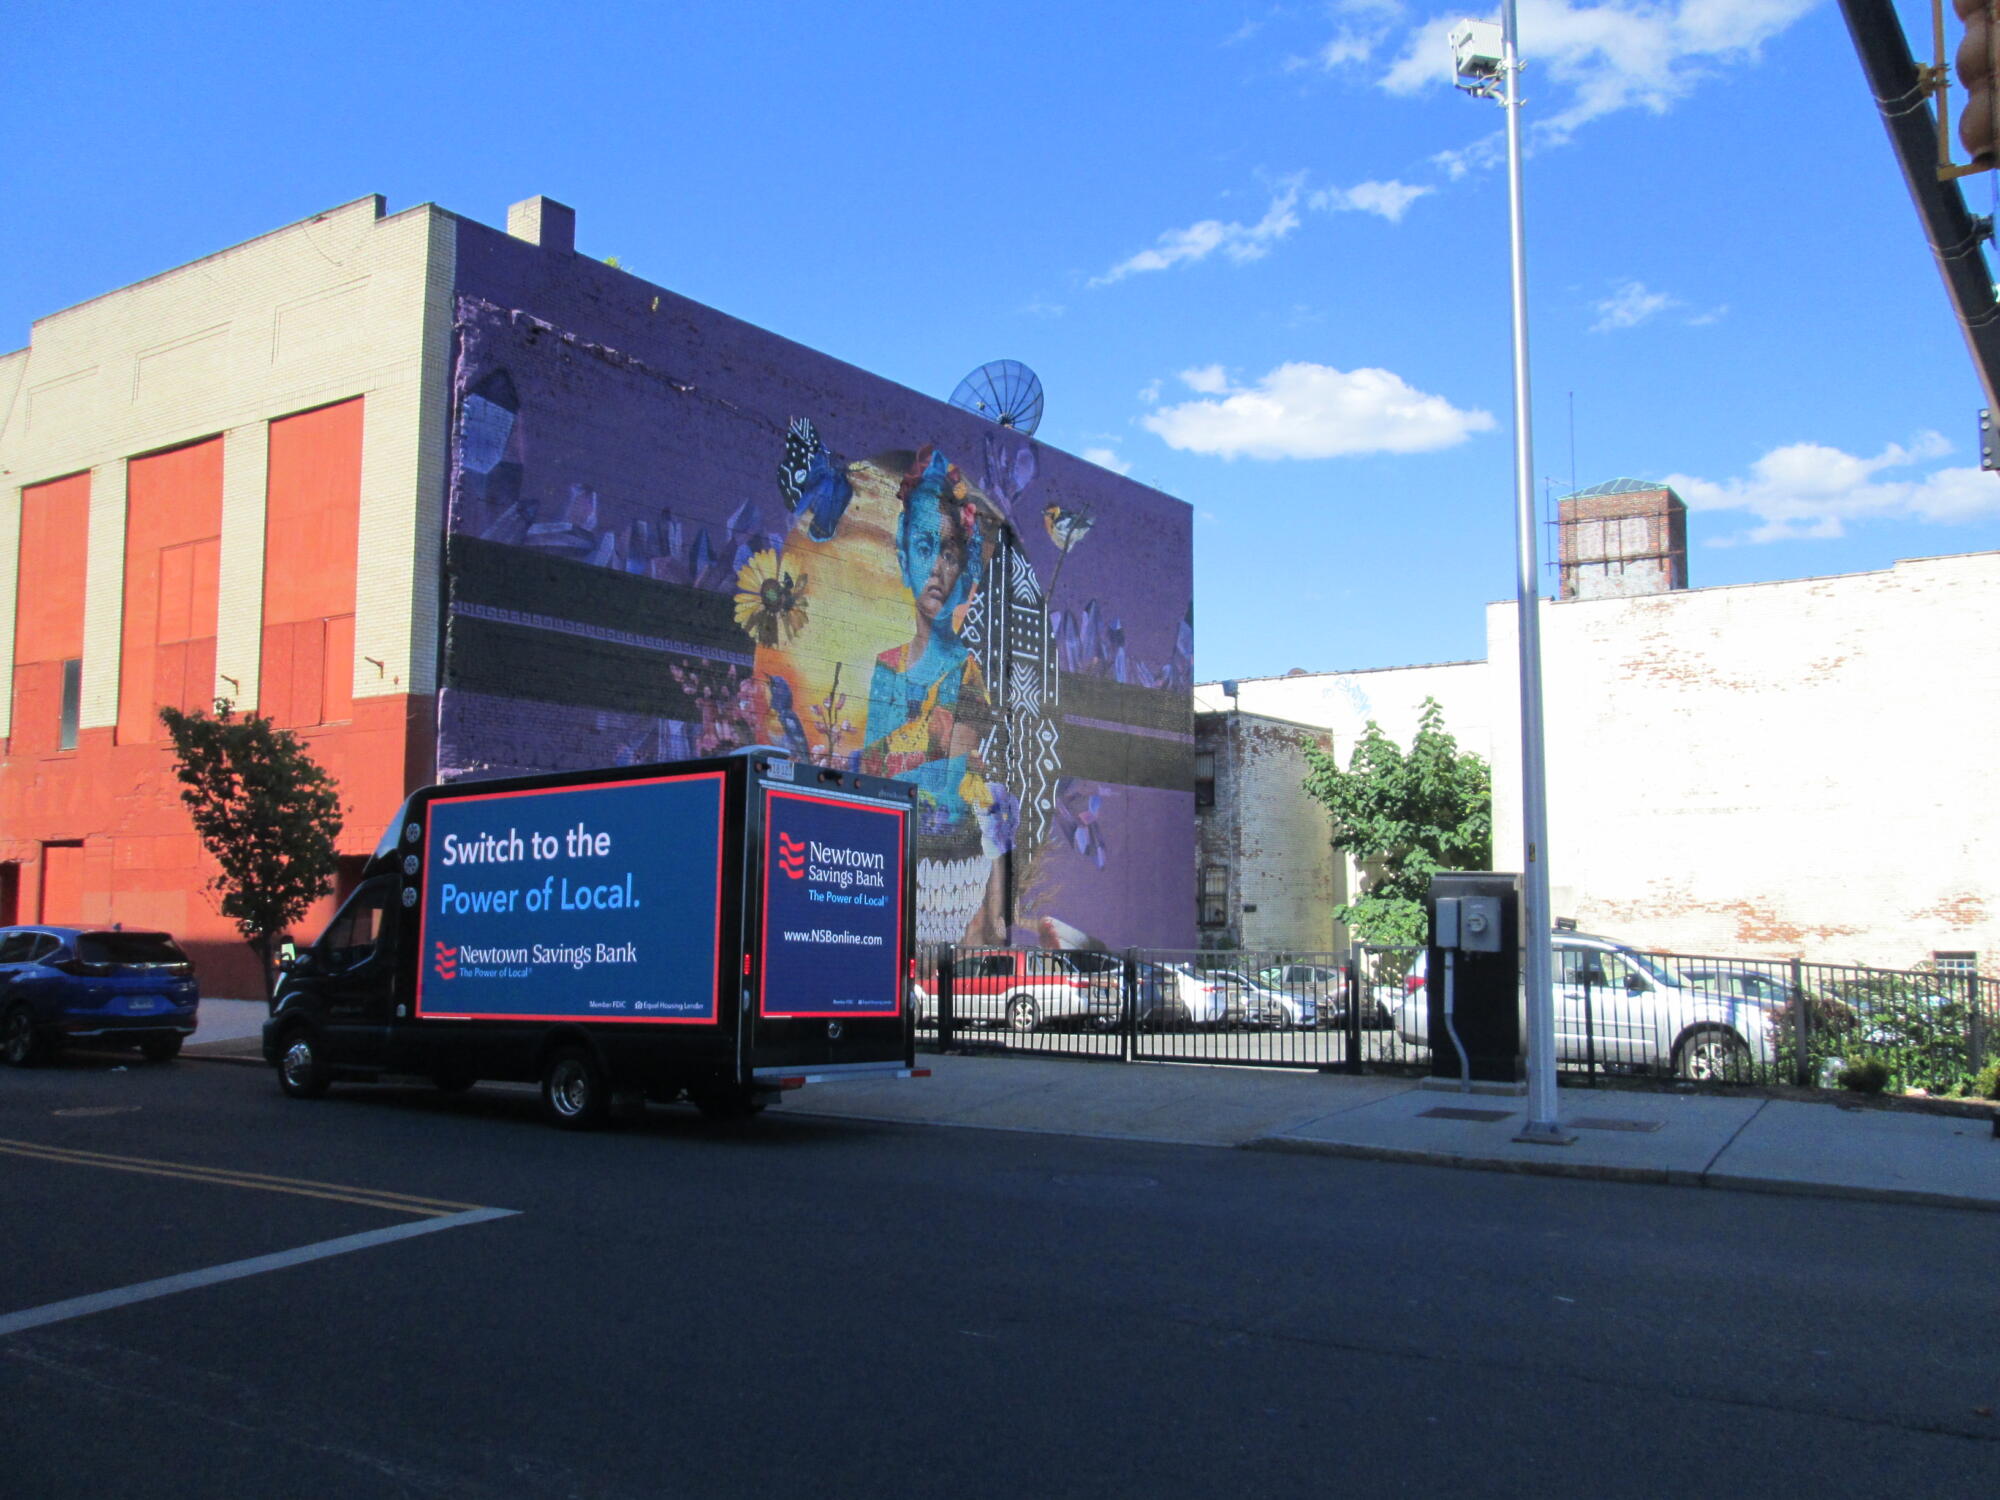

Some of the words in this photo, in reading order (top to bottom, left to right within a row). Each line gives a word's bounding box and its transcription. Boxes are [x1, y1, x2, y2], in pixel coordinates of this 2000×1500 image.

[442, 827, 524, 866] Switch
[531, 831, 559, 860] to
[566, 821, 611, 858] the
[809, 840, 885, 870] Newtown
[808, 864, 853, 889] Savings
[855, 869, 885, 888] Bank
[441, 883, 519, 914] Power
[525, 875, 554, 912] of
[560, 871, 640, 910] Local.
[808, 888, 825, 902] The
[826, 890, 852, 904] Power
[853, 892, 863, 905] of
[783, 928, 883, 945] www.NSBonline.com
[460, 945, 528, 964] Newtown
[532, 943, 592, 970] Savings
[595, 941, 638, 963] Bank
[459, 967, 473, 977] The
[474, 967, 497, 977] Power
[498, 966, 508, 977] of
[643, 1001, 659, 1010] Equal
[660, 1002, 683, 1011] Housing
[684, 1002, 704, 1010] Lender
